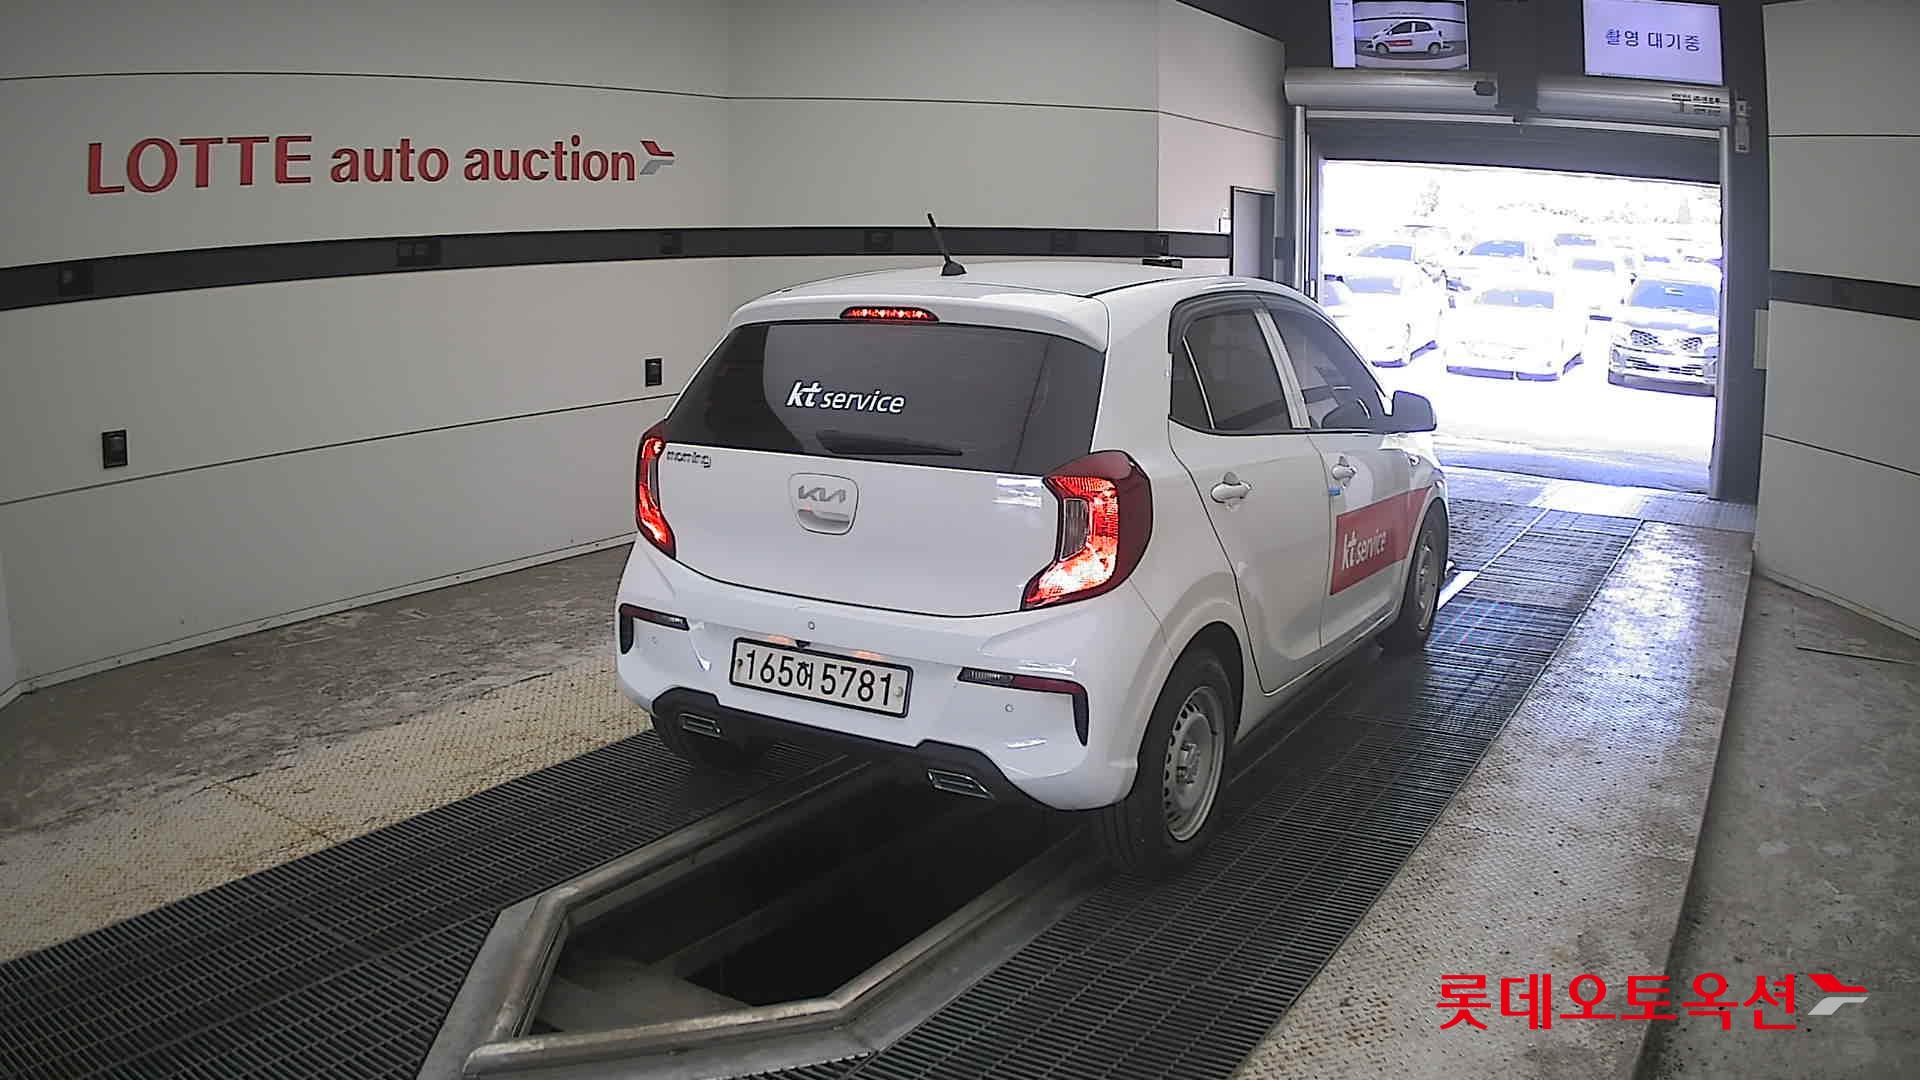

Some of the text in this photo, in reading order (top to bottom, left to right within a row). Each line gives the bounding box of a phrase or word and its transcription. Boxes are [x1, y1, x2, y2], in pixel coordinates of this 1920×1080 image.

[1647, 31, 1701, 52] 대기중
[87, 134, 636, 194] LOTTE auto auction
[785, 380, 906, 414] kt service
[1341, 530, 1358, 572] kt
